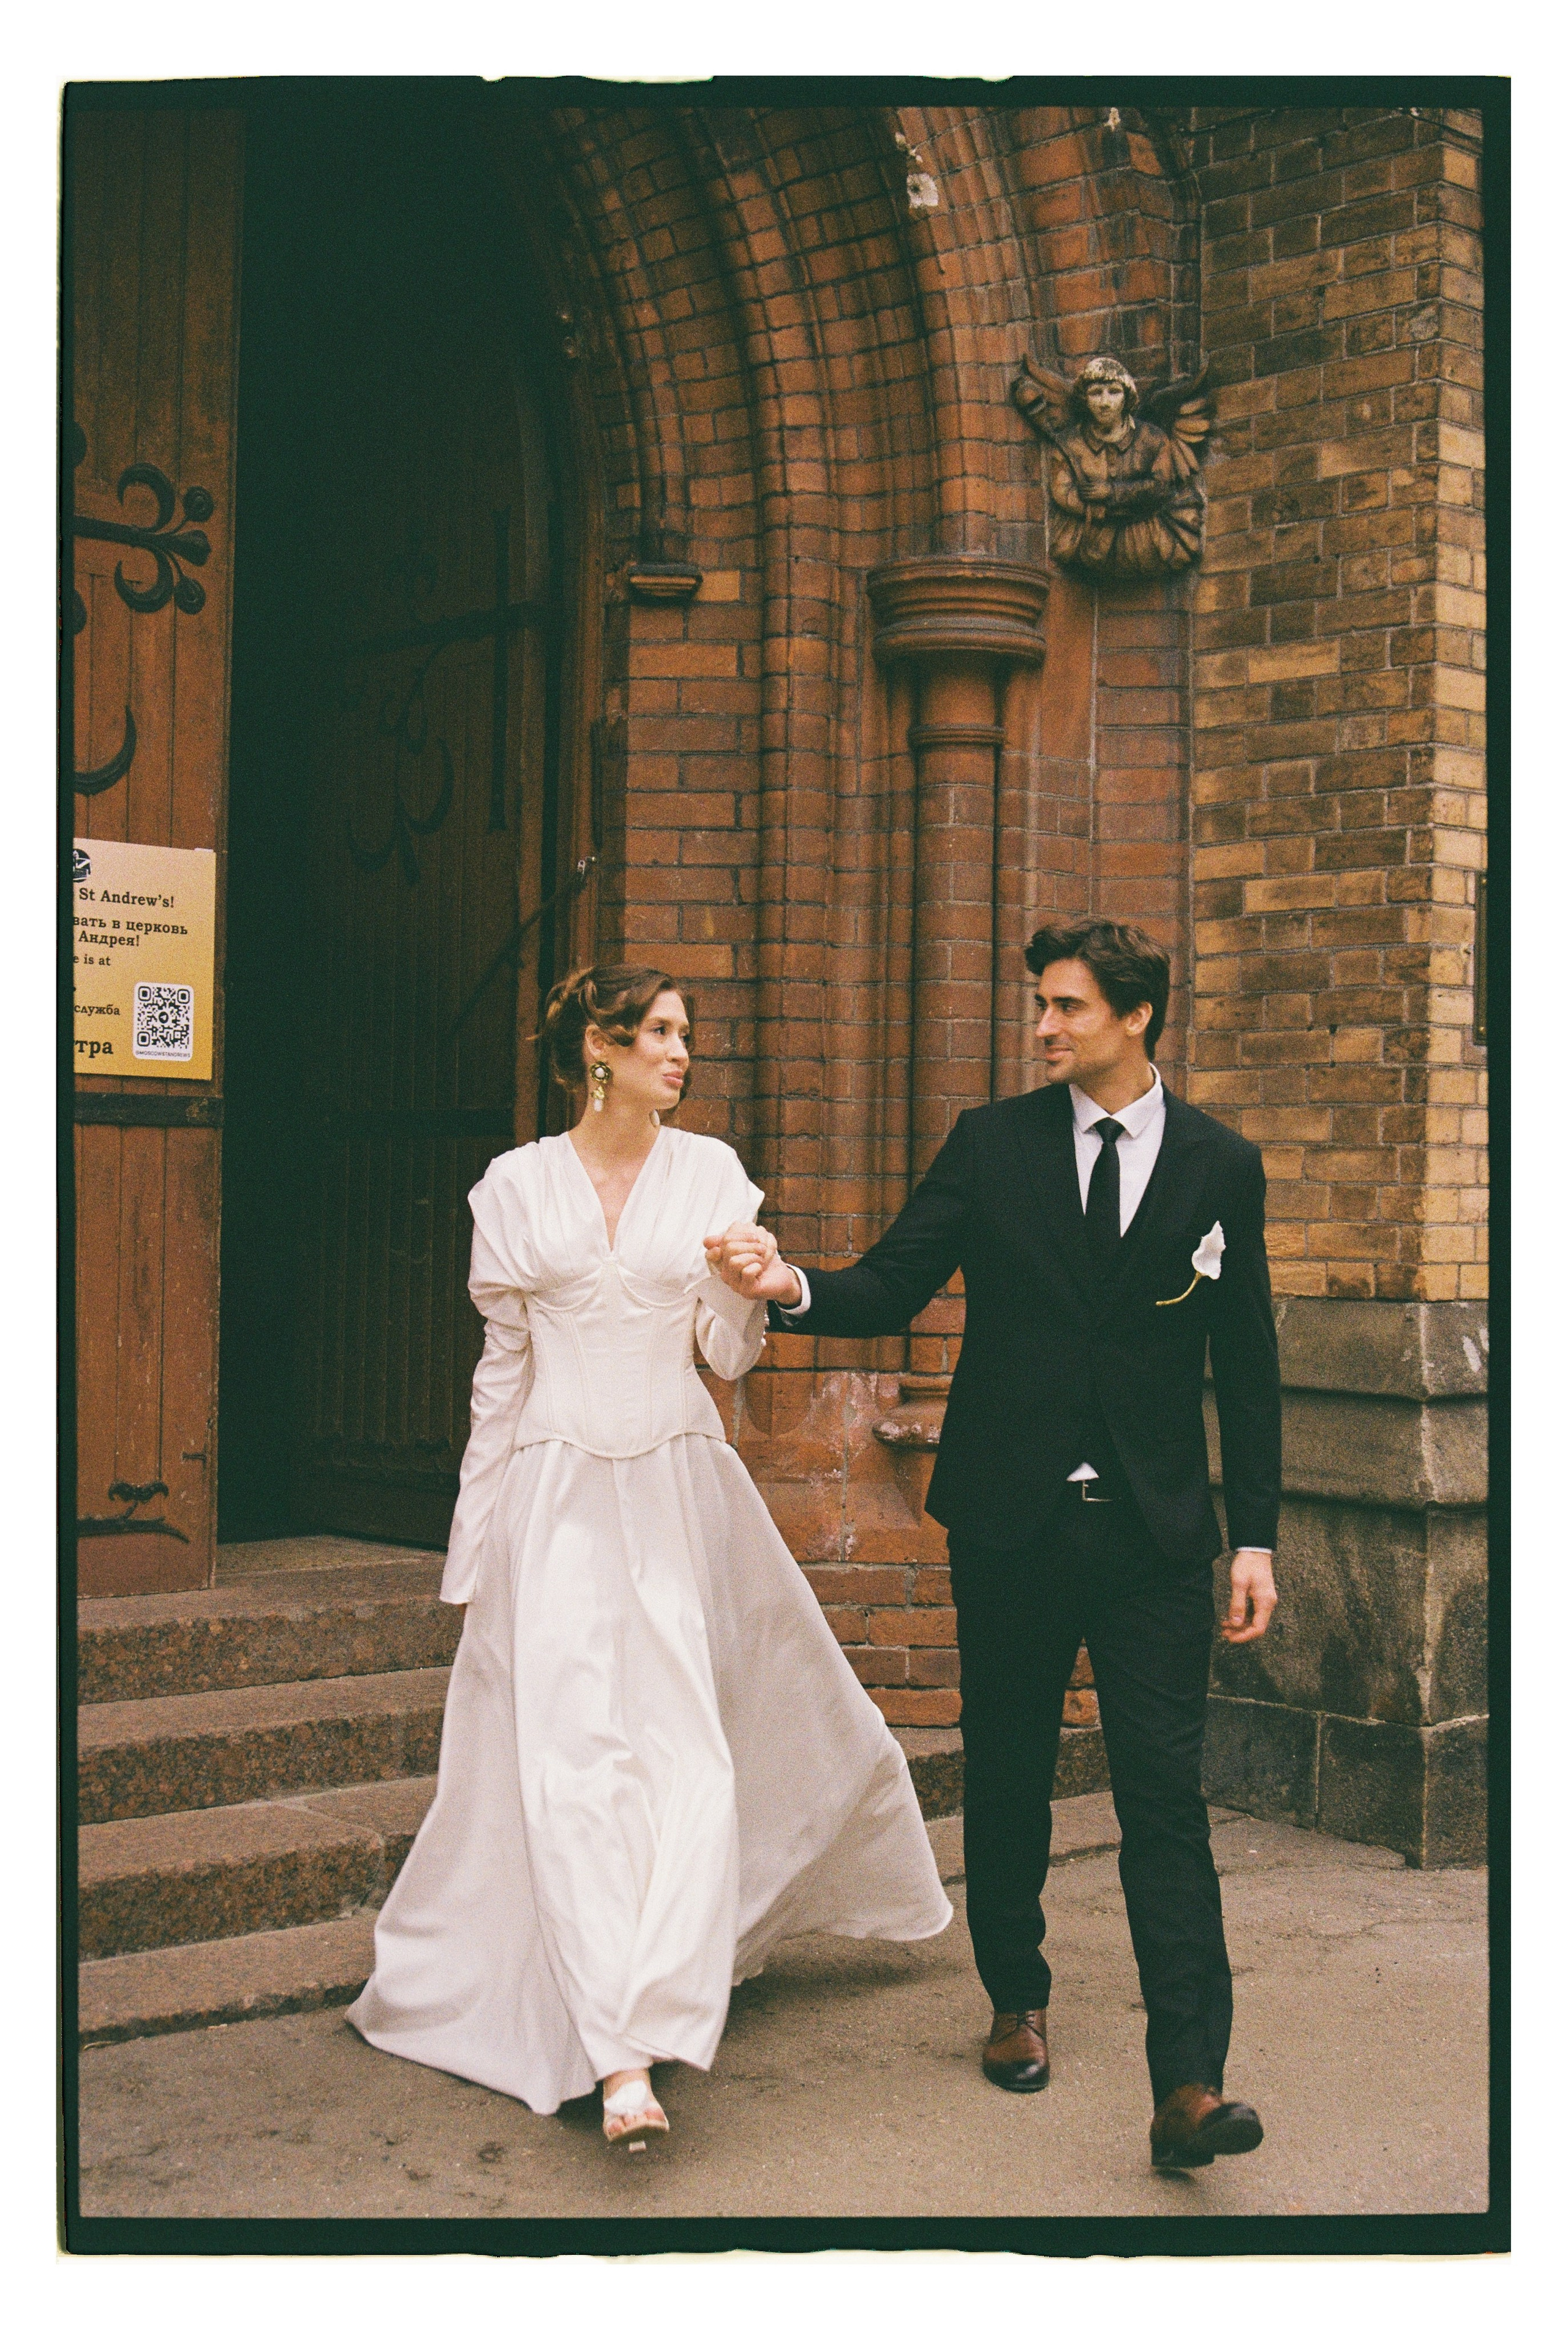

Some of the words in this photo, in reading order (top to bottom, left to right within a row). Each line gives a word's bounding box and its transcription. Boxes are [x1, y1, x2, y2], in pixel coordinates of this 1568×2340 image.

[79, 888, 95, 901] St
[111, 919, 121, 929] в
[126, 920, 188, 935] церковь
[78, 930, 140, 948] Андрея!
[83, 954, 94, 965] is
[99, 956, 111, 967] at
[74, 1004, 121, 1017] служба
